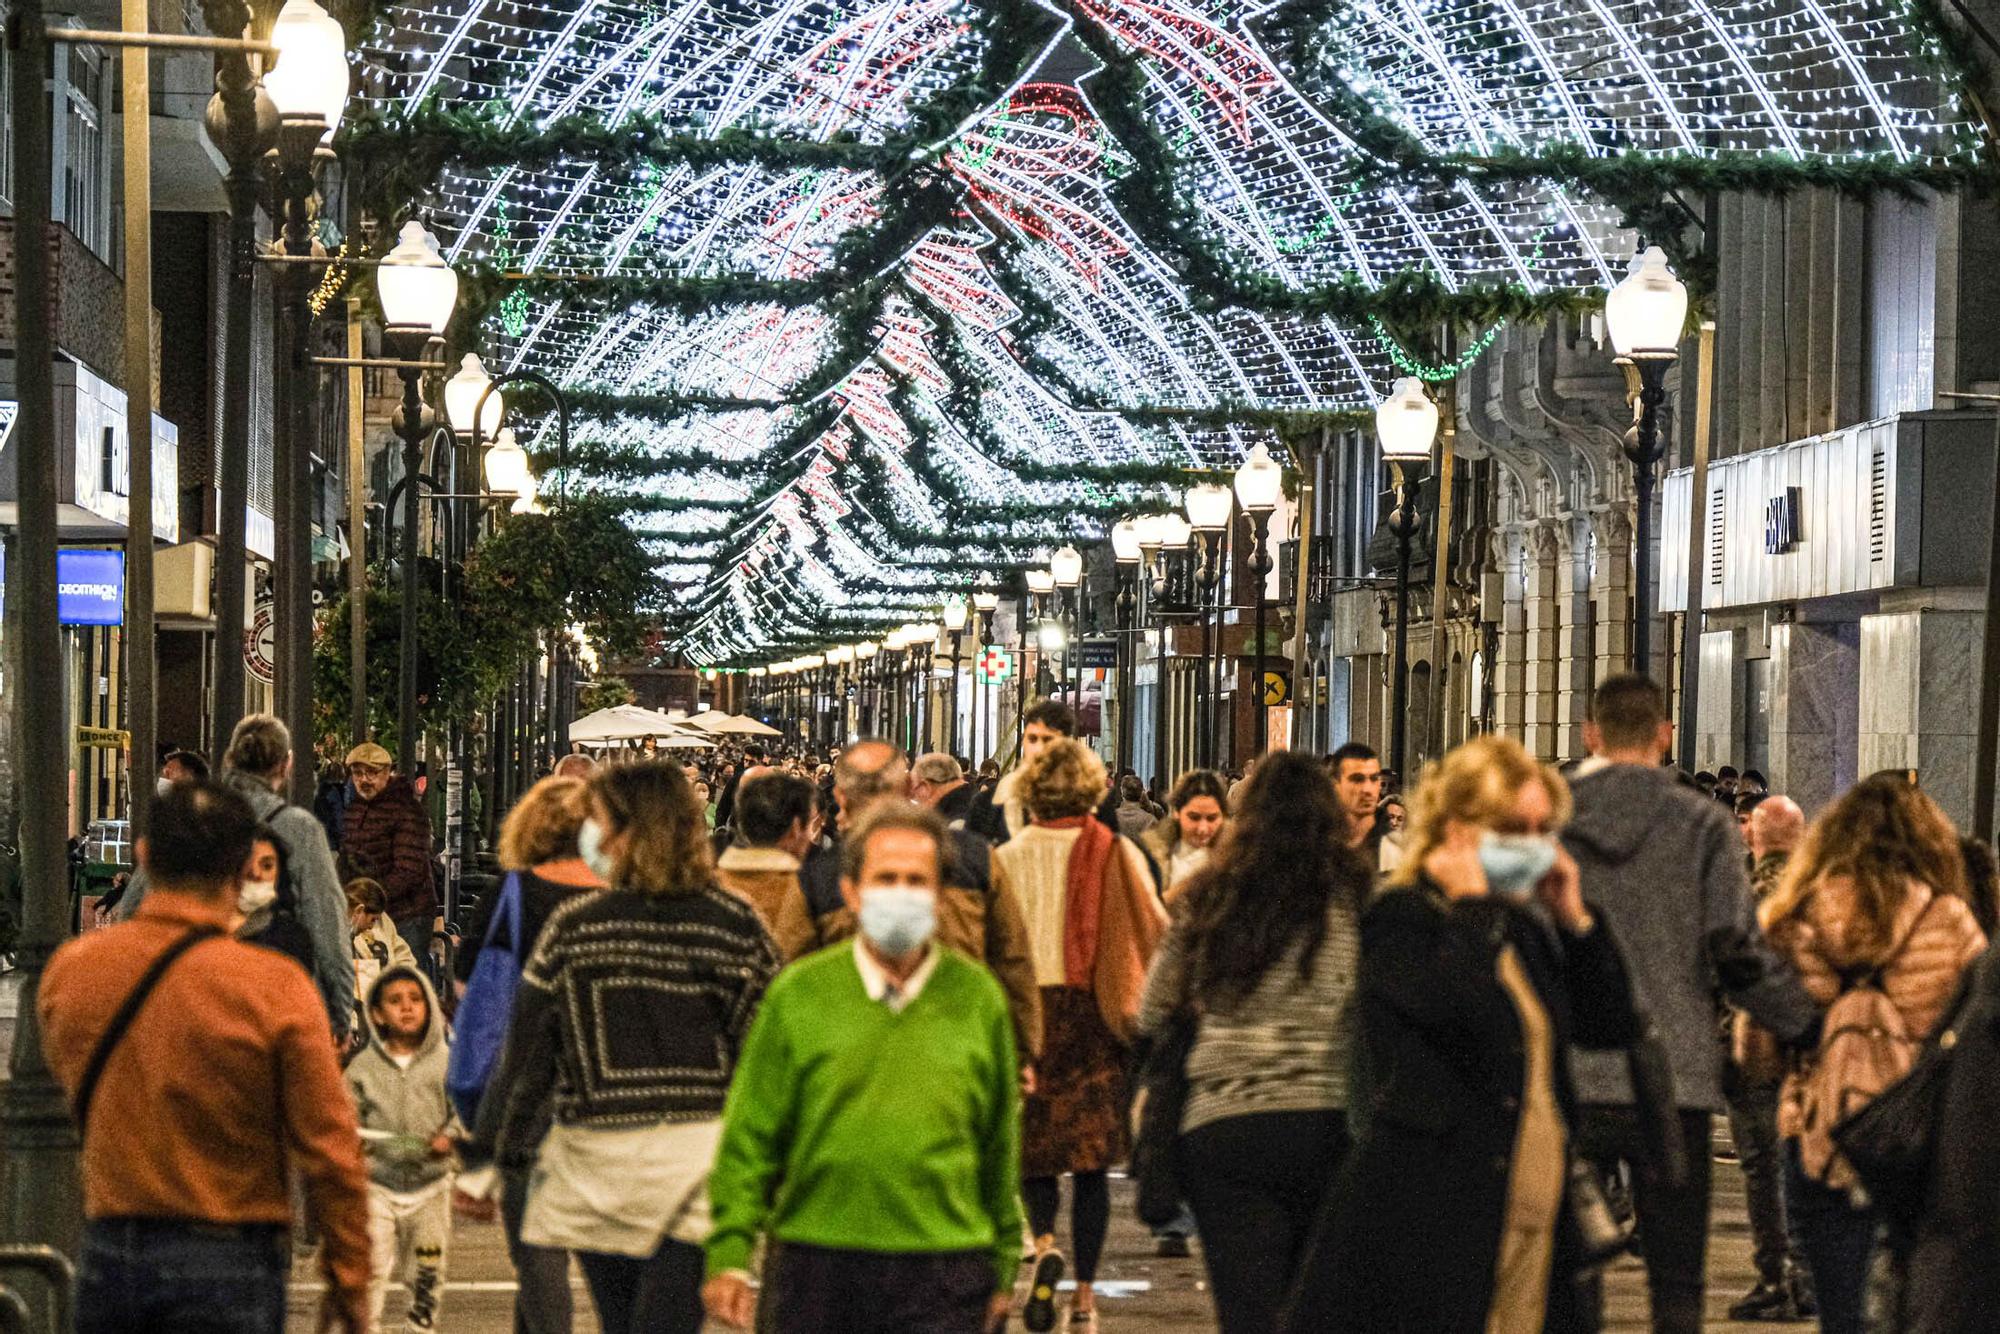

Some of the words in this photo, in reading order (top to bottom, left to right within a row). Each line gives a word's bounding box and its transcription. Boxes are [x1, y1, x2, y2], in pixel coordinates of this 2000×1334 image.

[1765, 495, 1789, 554] BBVA
[59, 583, 117, 596] DECATHLON
[91, 733, 120, 742] ONCE
